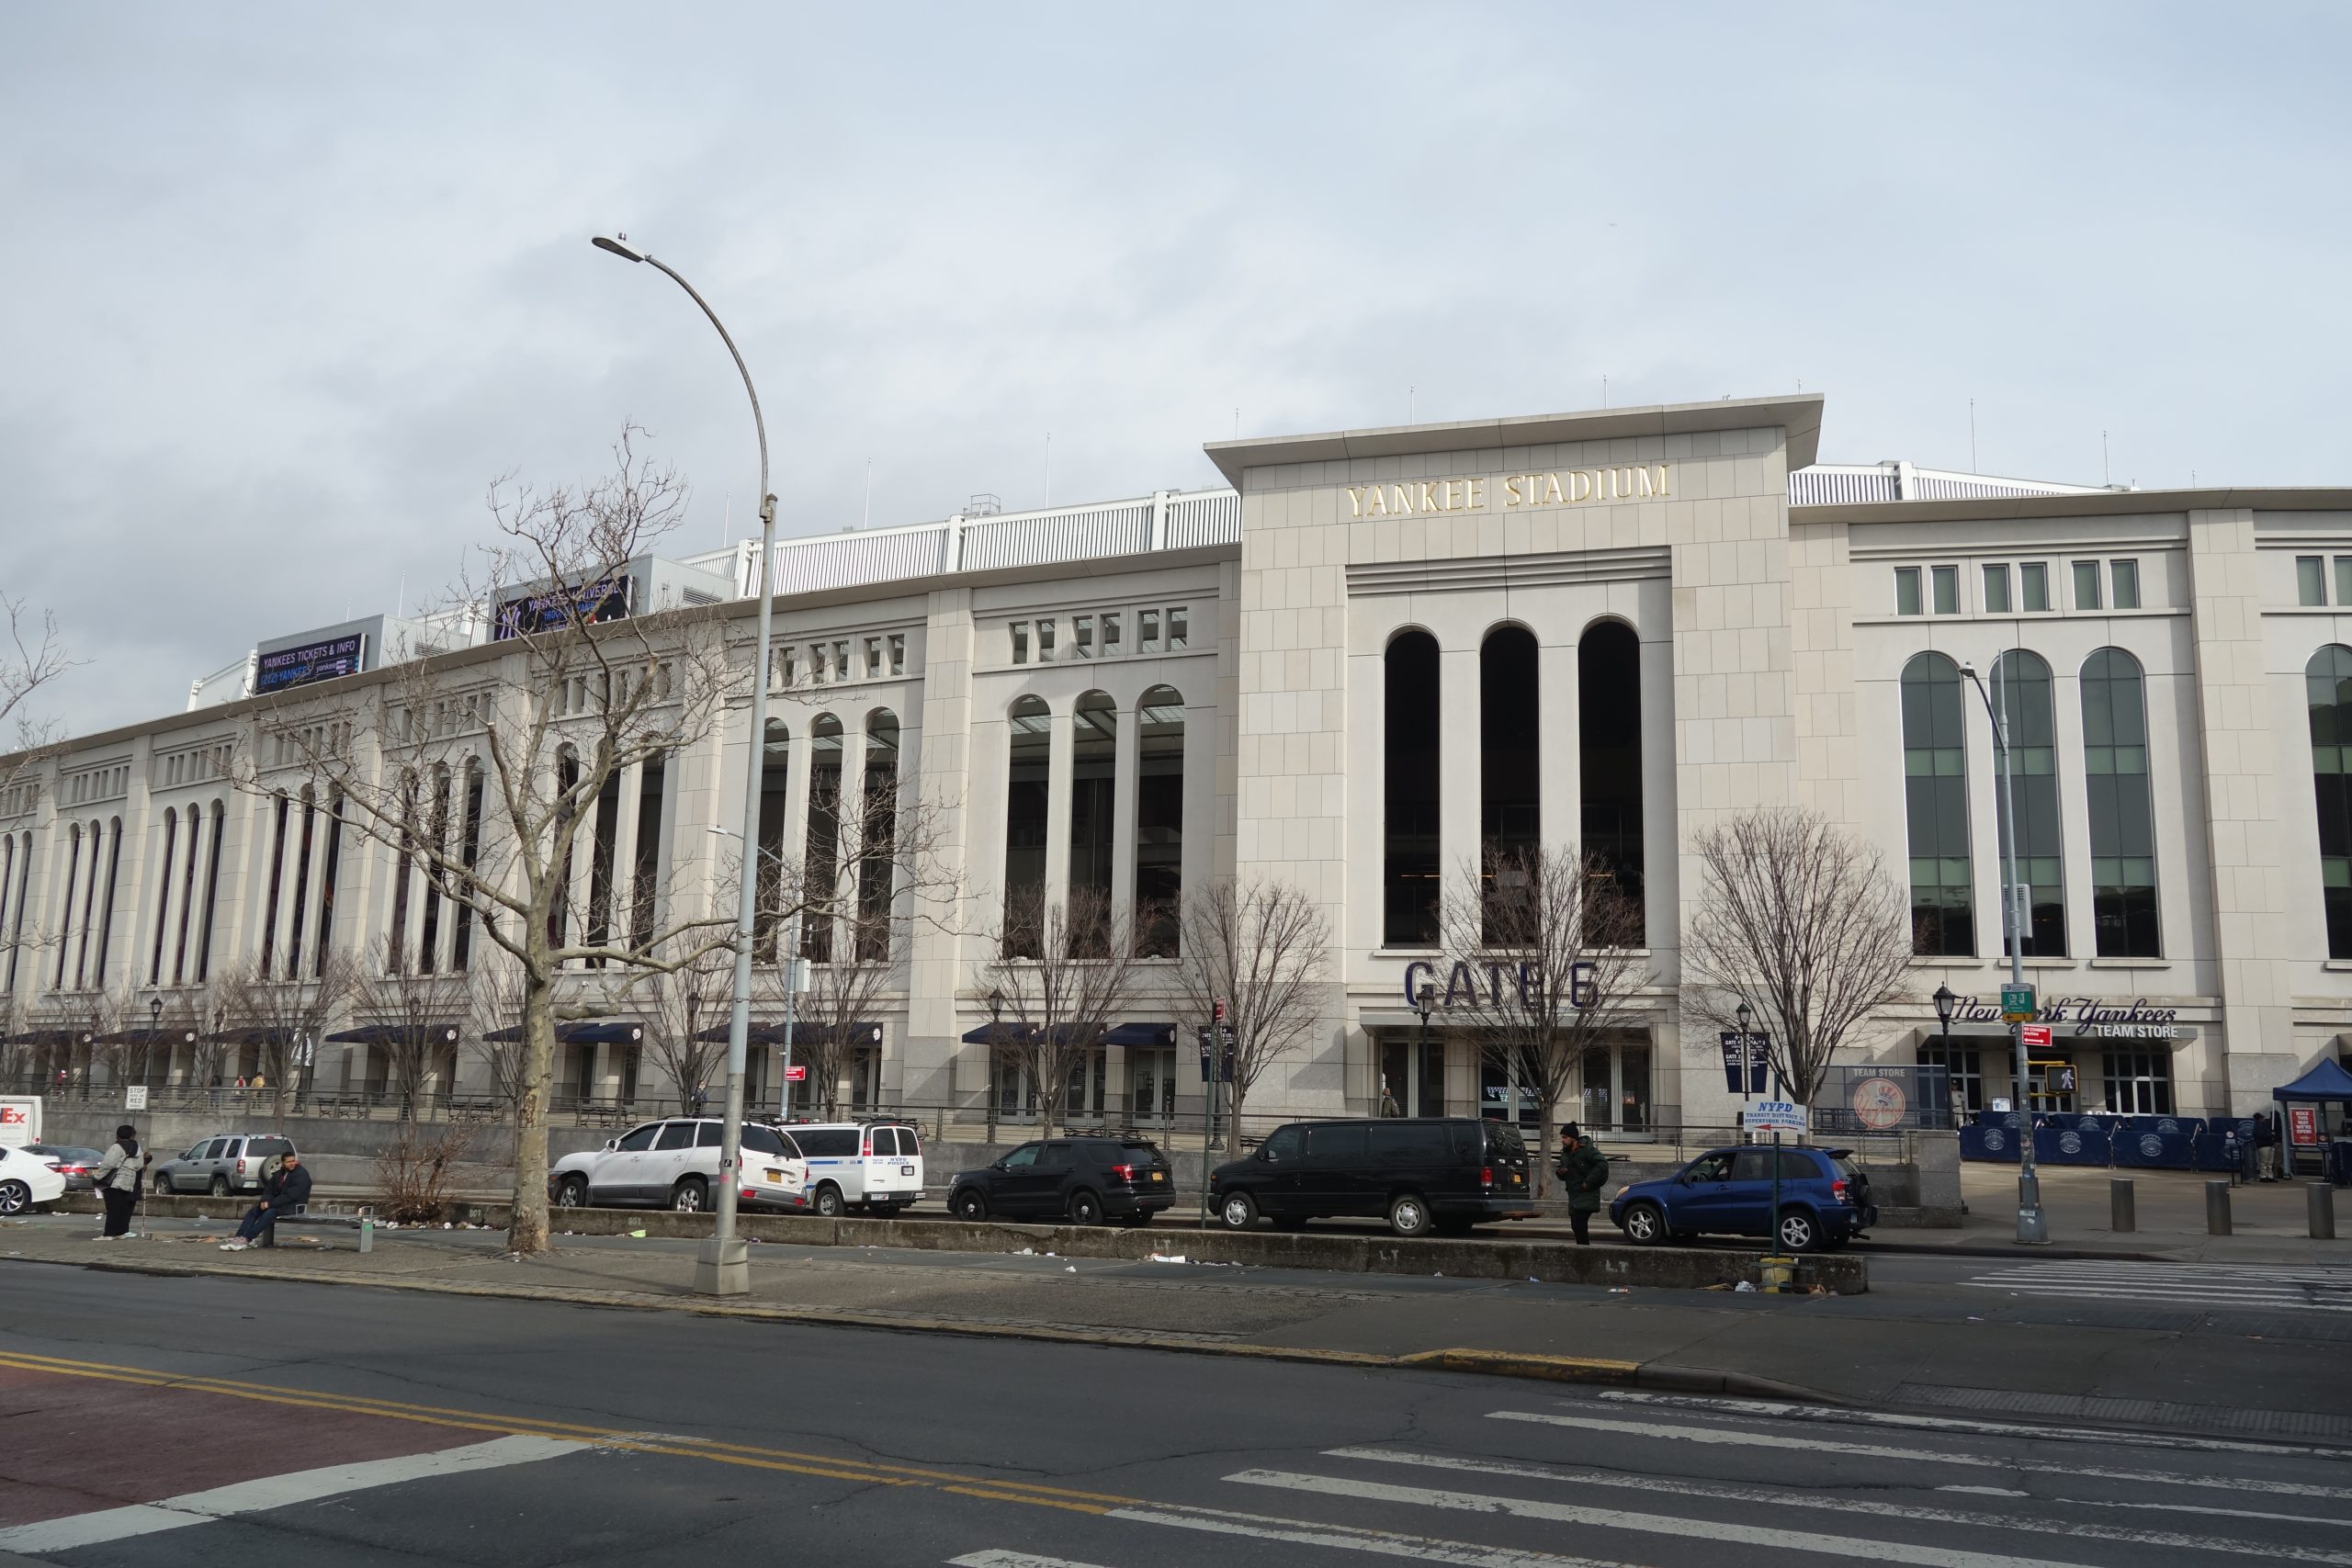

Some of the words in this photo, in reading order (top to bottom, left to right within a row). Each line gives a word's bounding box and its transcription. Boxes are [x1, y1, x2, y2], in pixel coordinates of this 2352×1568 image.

[1346, 477, 1486, 518] YANKEE
[1504, 464, 1671, 507] STADIUM
[264, 652, 296, 669] YANKEES
[298, 646, 327, 662] TICKETS
[329, 645, 335, 655] &
[336, 640, 356, 654] INFO
[1404, 961, 1544, 1009] GATE
[1570, 961, 1599, 1009] 6
[2072, 998, 2177, 1036] Yankees
[2095, 1024, 2135, 1038] TEAM
[2137, 1024, 2179, 1039] STORE
[1852, 1068, 1876, 1077] TEAM
[1878, 1068, 1905, 1077] STORE
[1758, 1101, 1793, 1112] NYPD
[1781, 1119, 1806, 1127] PARKING
